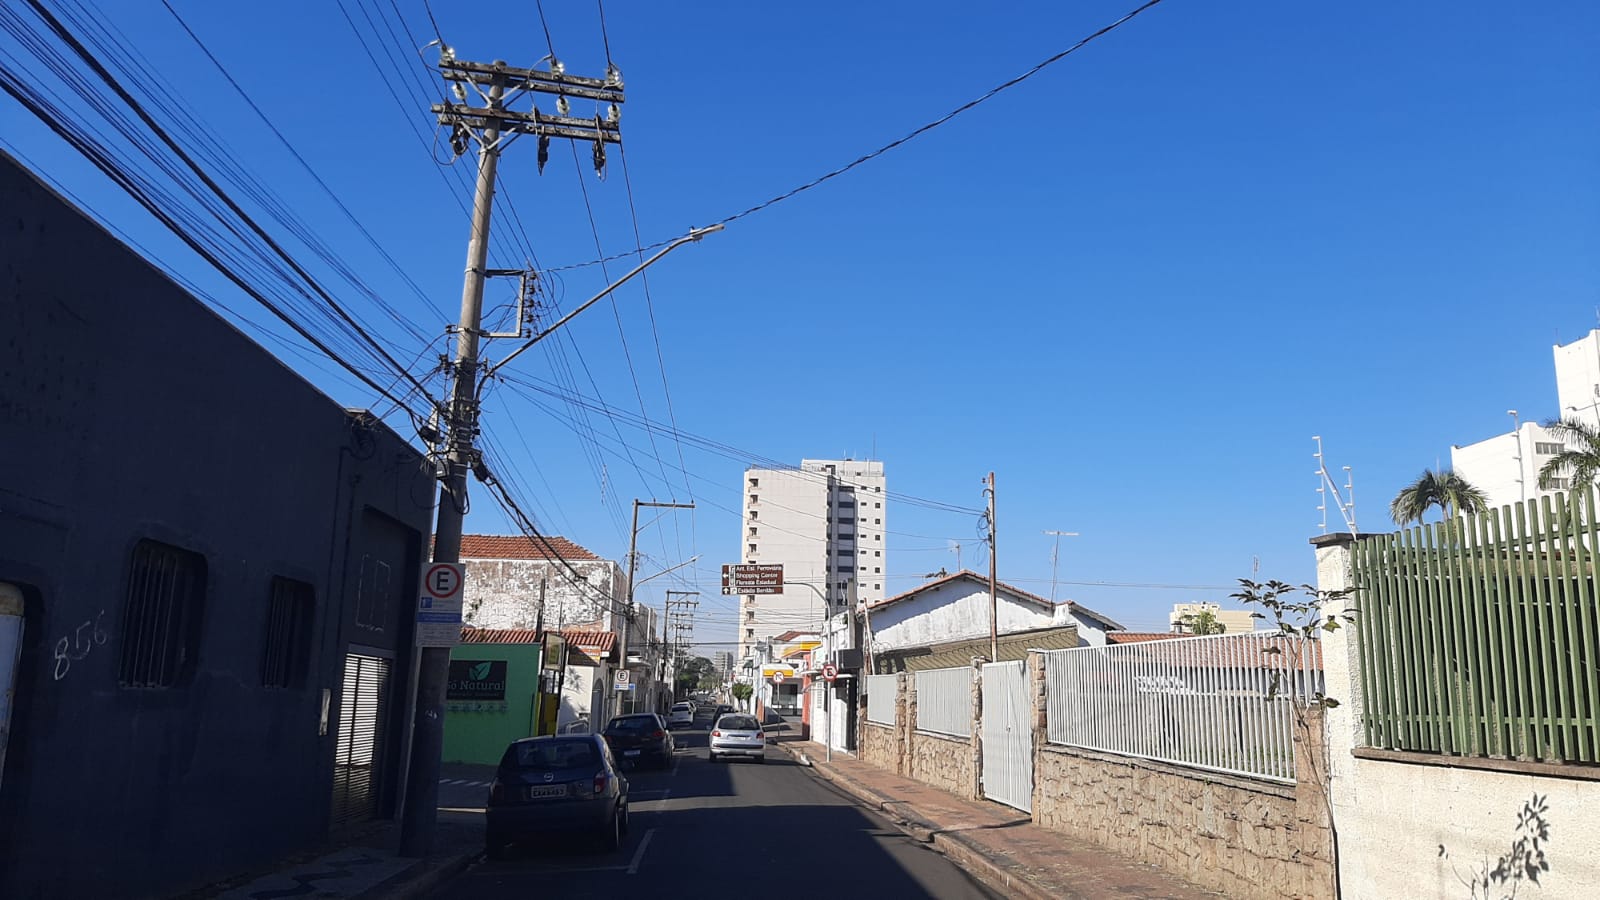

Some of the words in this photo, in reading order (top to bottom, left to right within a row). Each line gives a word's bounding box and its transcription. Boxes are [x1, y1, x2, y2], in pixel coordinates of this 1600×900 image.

[437, 572, 449, 590] E
[55, 608, 107, 680] 856
[459, 680, 505, 690] Natural
